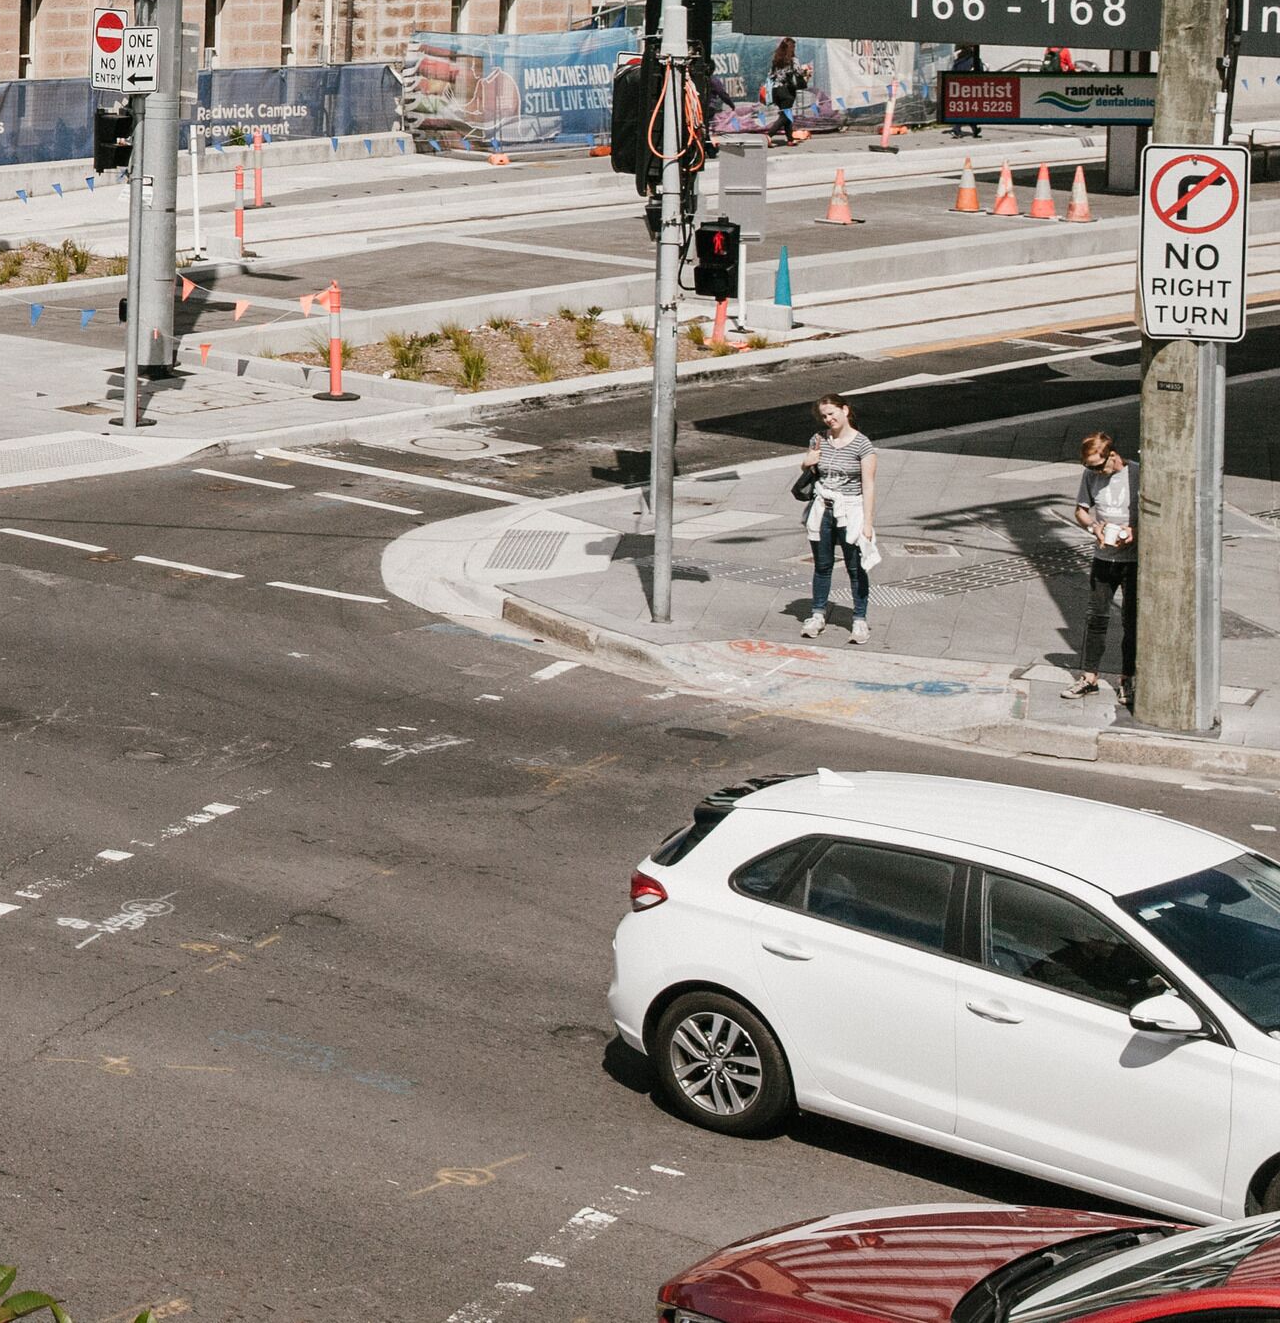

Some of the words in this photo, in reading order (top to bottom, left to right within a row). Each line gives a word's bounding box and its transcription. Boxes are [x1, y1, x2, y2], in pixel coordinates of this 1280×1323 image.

[128, 34, 153, 48] ONE
[100, 58, 117, 70] NO
[126, 54, 154, 68] WAY
[95, 72, 121, 85] ENTRY
[523, 64, 588, 90] MAGAZINES
[588, 63, 610, 85] AND
[948, 81, 1013, 99] Dentist
[1064, 84, 1124, 96] randwick
[525, 90, 560, 114] STILL
[561, 88, 585, 111] LIVE
[585, 87, 613, 109] HERE
[949, 101, 979, 113] 9314
[982, 101, 1013, 113] 5226
[1095, 97, 1155, 108] dentalclinic
[197, 103, 255, 121] Radwick
[257, 103, 308, 119] Campus
[1164, 242, 1220, 271] NO
[1151, 277, 1232, 299] RIGHT
[1154, 305, 1228, 326] TURN
